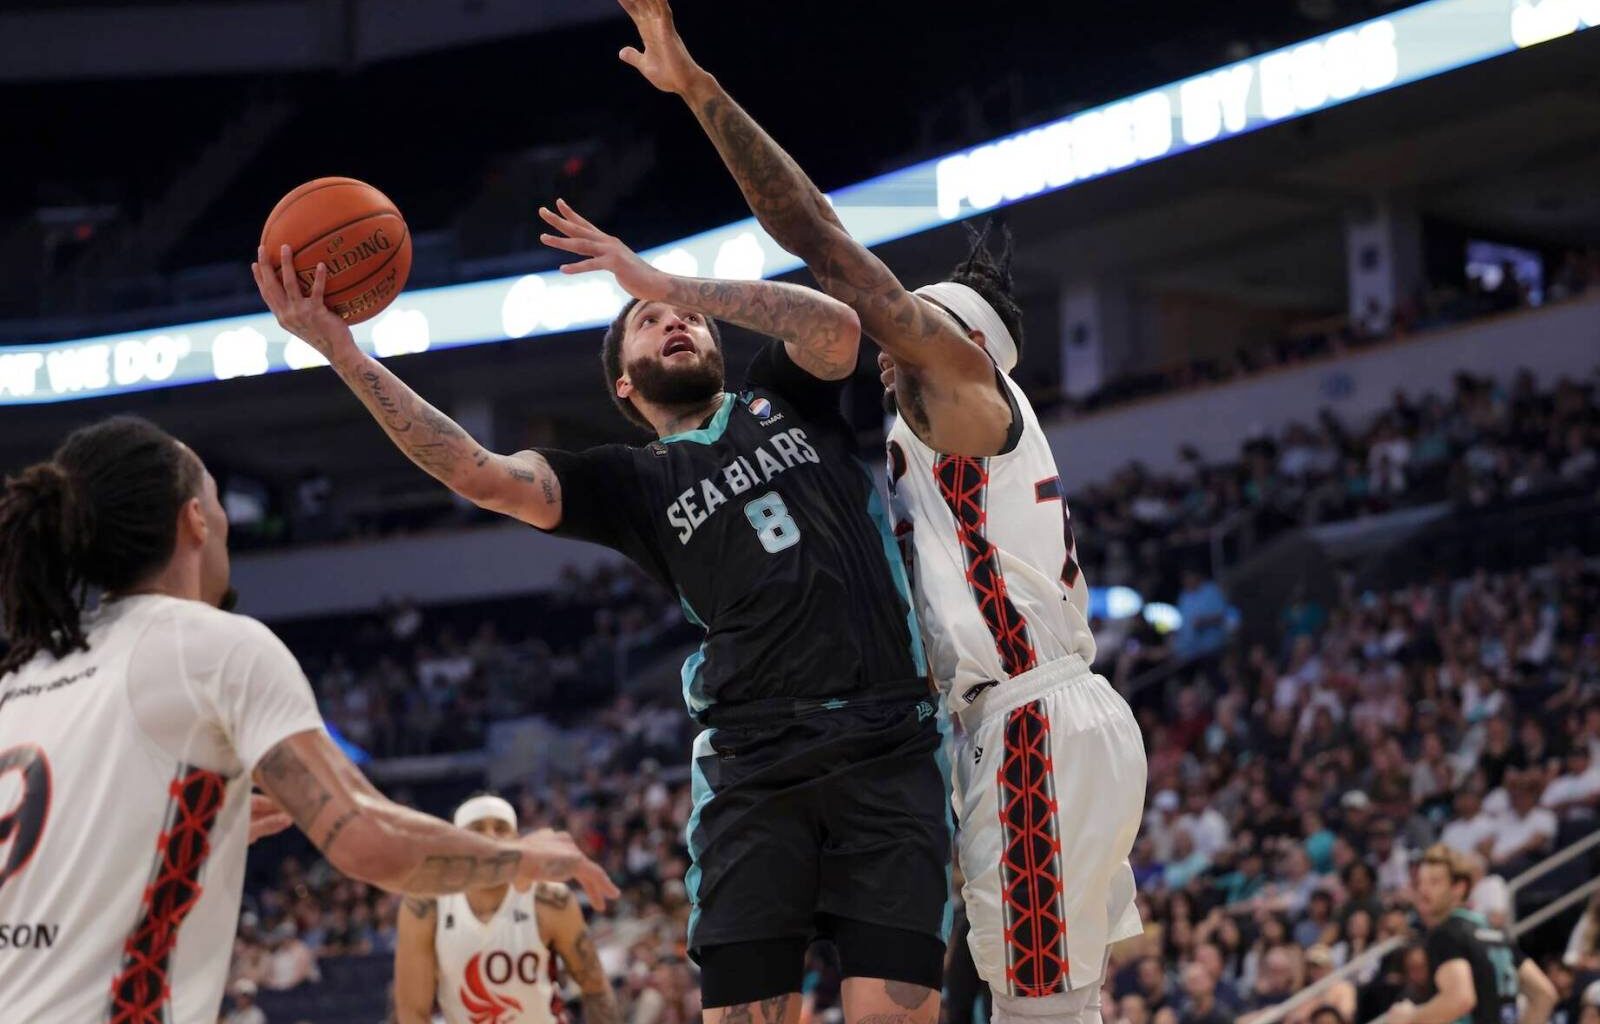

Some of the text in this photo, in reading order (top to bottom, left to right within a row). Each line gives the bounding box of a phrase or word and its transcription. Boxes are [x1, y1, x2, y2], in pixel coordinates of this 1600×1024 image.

[1180, 64, 1254, 146] BY
[666, 478, 728, 546] SEA
[743, 490, 801, 554] 8
